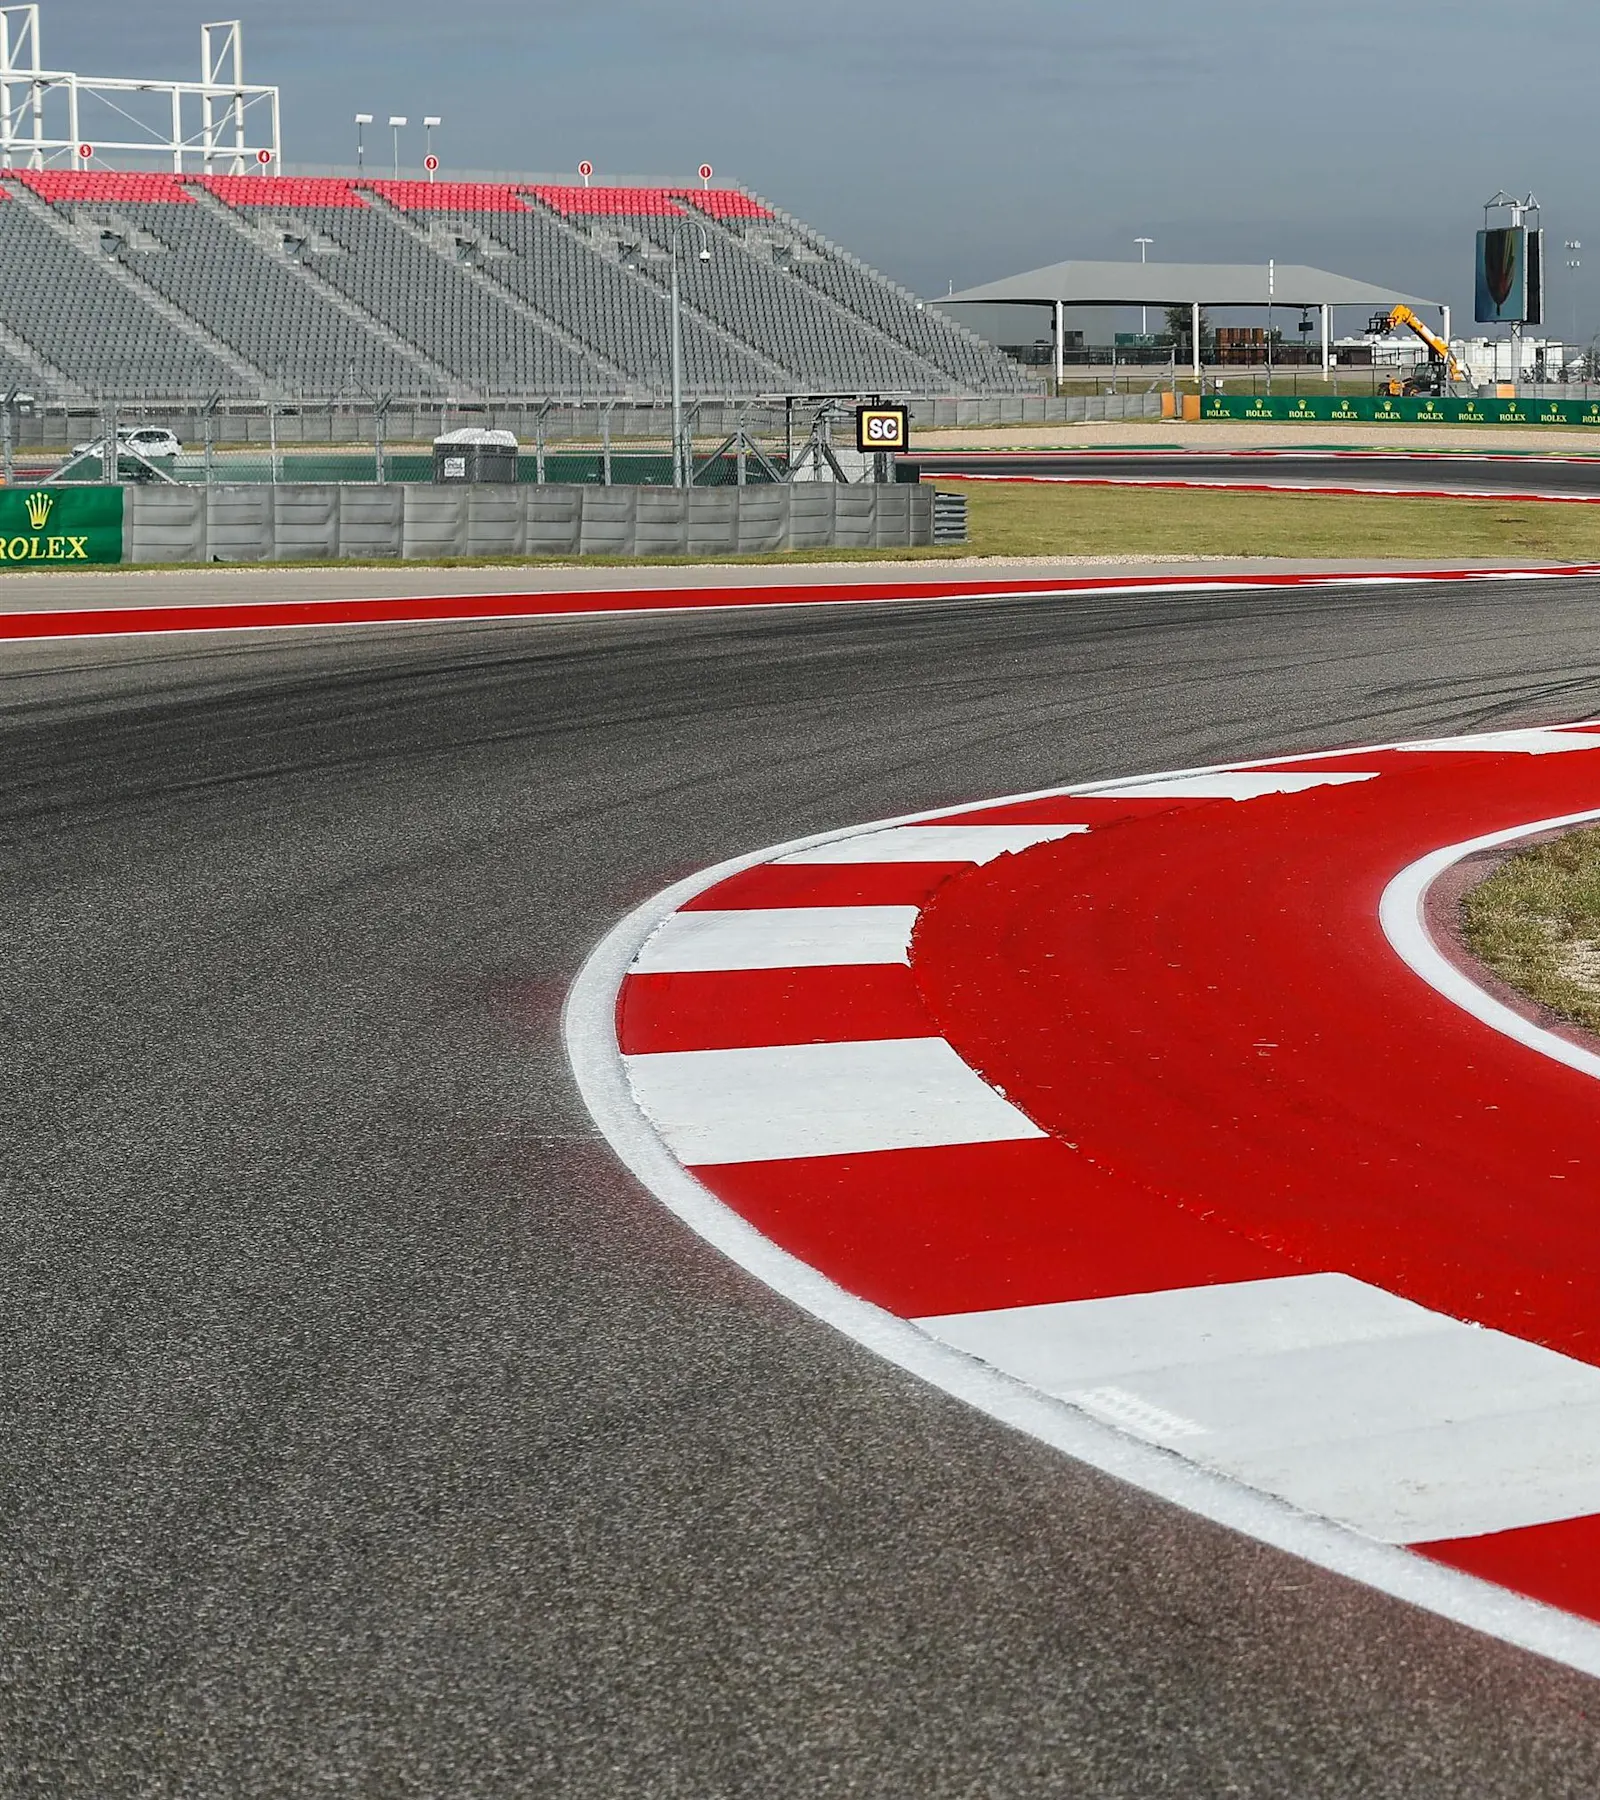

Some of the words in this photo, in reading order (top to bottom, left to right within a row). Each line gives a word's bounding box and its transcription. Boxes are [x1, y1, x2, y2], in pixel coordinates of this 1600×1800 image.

[1246, 410, 1272, 418] ROLEX
[1289, 410, 1315, 418] ROLEX
[1331, 411, 1358, 419] ROLEX
[1375, 412, 1401, 420] ROLEX
[1417, 412, 1443, 420] ROLEX
[1458, 413, 1484, 421] ROLEX
[869, 418, 897, 439] SC
